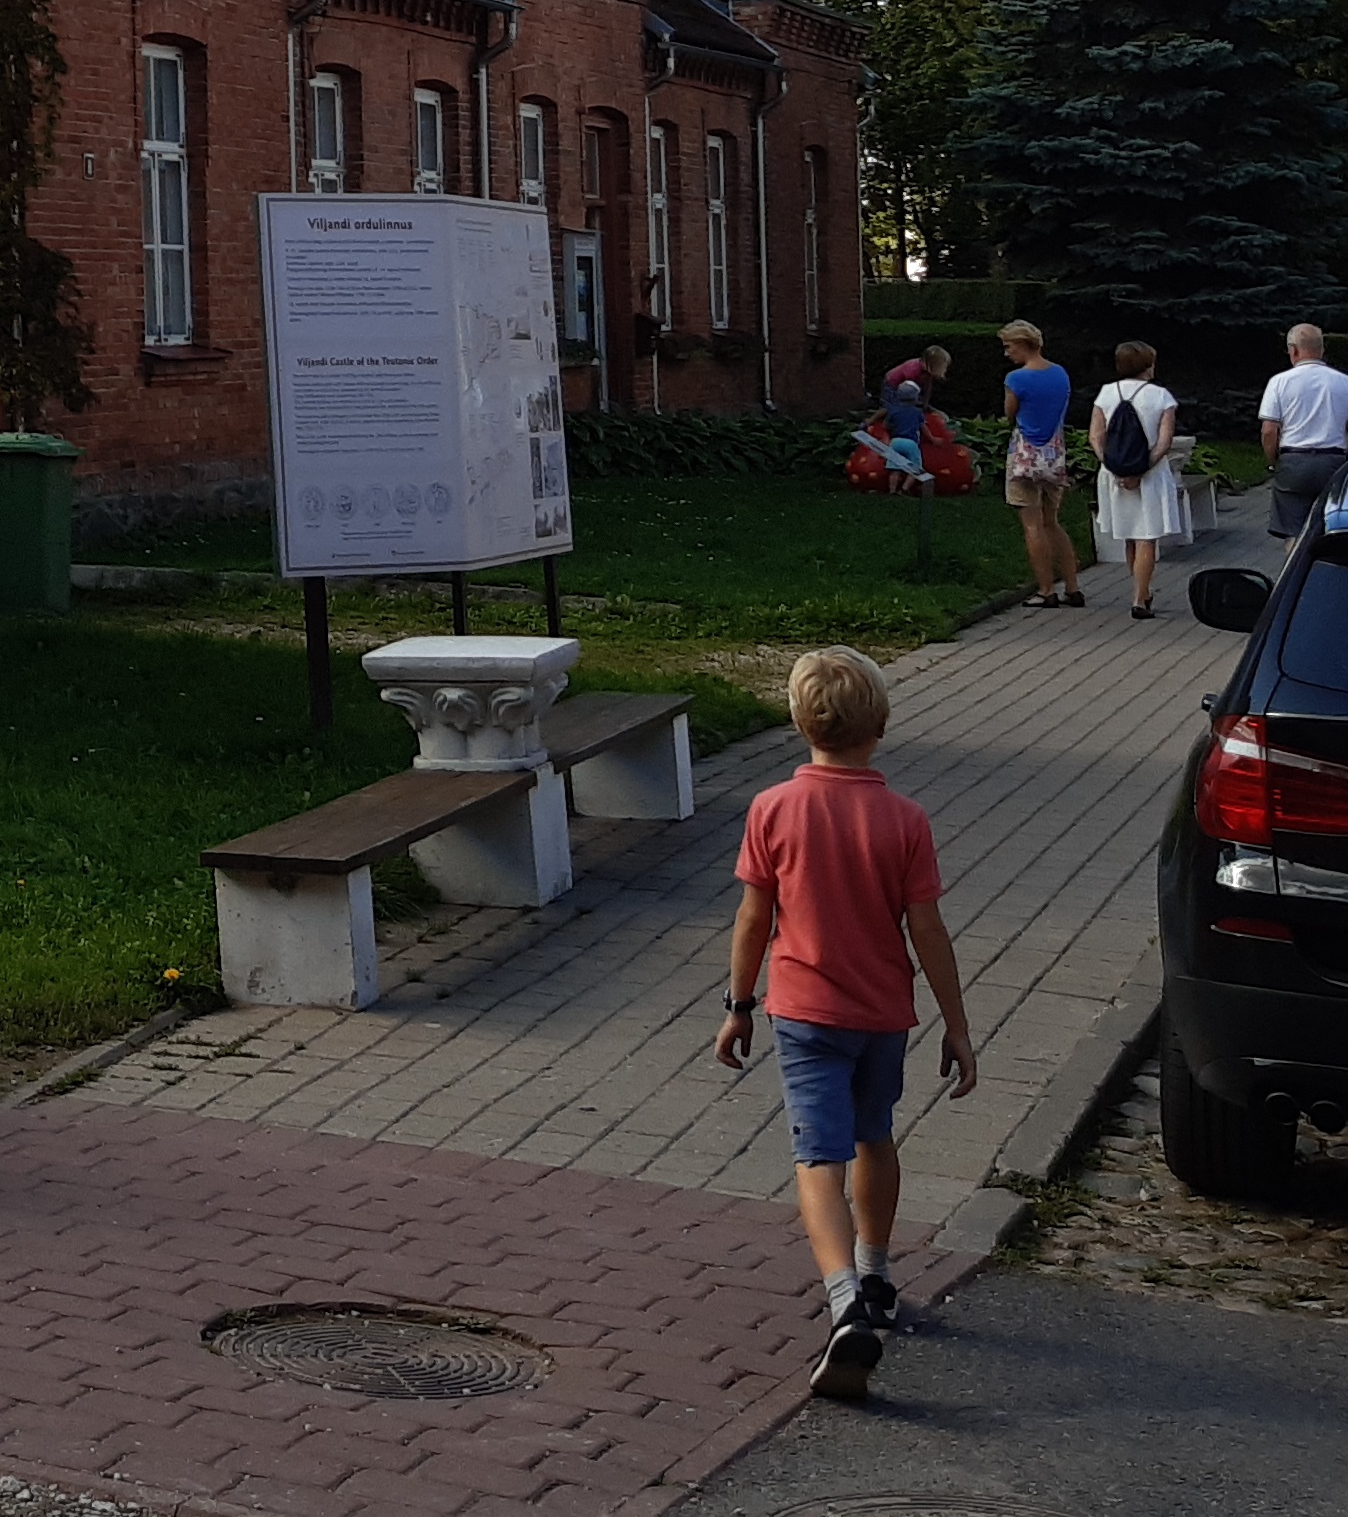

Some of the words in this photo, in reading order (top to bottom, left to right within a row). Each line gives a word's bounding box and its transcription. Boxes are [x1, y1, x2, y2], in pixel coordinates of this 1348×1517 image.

[307, 217, 351, 232] Viljandi
[354, 218, 413, 230] ordulinnus
[297, 357, 328, 369] Viljandi
[329, 357, 355, 366] Castle
[356, 356, 365, 366] of
[366, 356, 379, 366] the
[416, 356, 439, 365] Order
